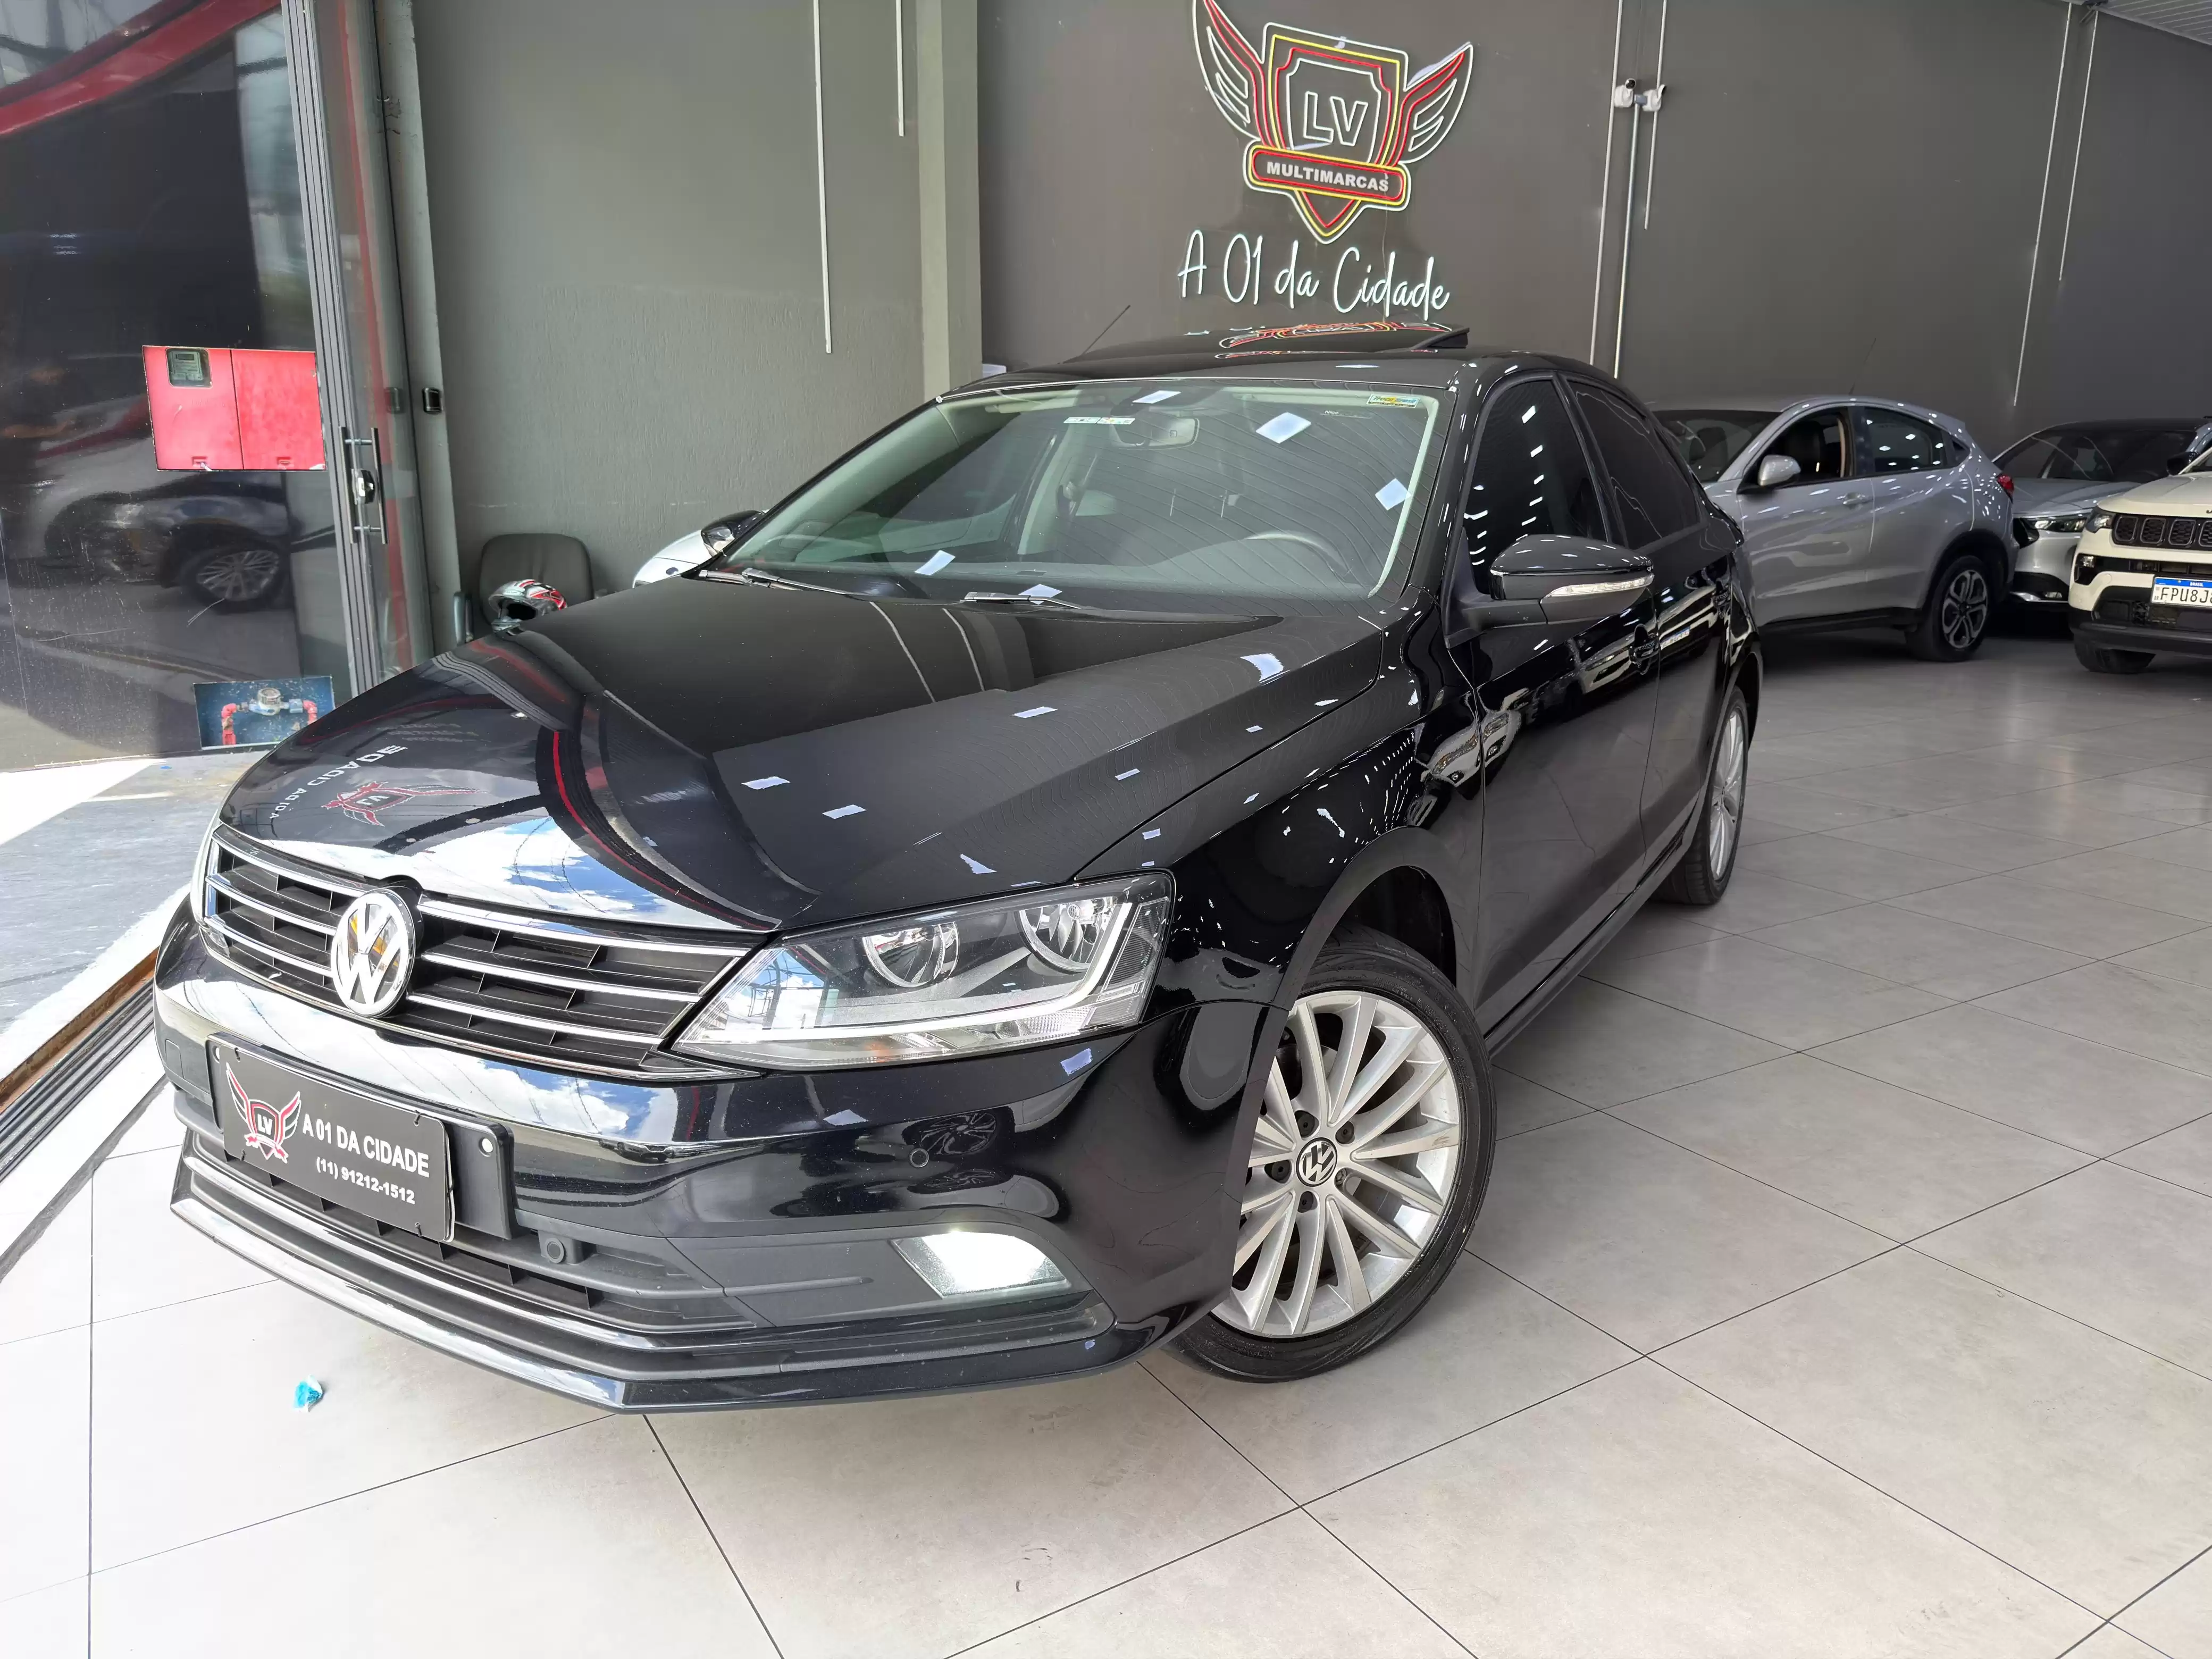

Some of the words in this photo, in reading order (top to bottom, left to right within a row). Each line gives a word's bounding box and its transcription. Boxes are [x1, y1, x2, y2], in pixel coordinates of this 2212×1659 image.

[1303, 91, 1368, 146] LV
[1267, 161, 1389, 192] MULTIMARCAS
[1178, 229, 1206, 298] A
[1223, 233, 1263, 305] 01
[1274, 240, 1320, 309] da
[1334, 247, 1450, 321] Cidade
[2160, 587, 2212, 604] FPU8J
[257, 1114, 273, 1136] LV
[303, 1113, 314, 1137] A
[316, 1118, 332, 1144] 01
[337, 1125, 361, 1155] DA
[363, 1135, 430, 1178] CIDADE
[316, 1157, 339, 1180] (11)
[341, 1167, 416, 1205] 91212-1512
